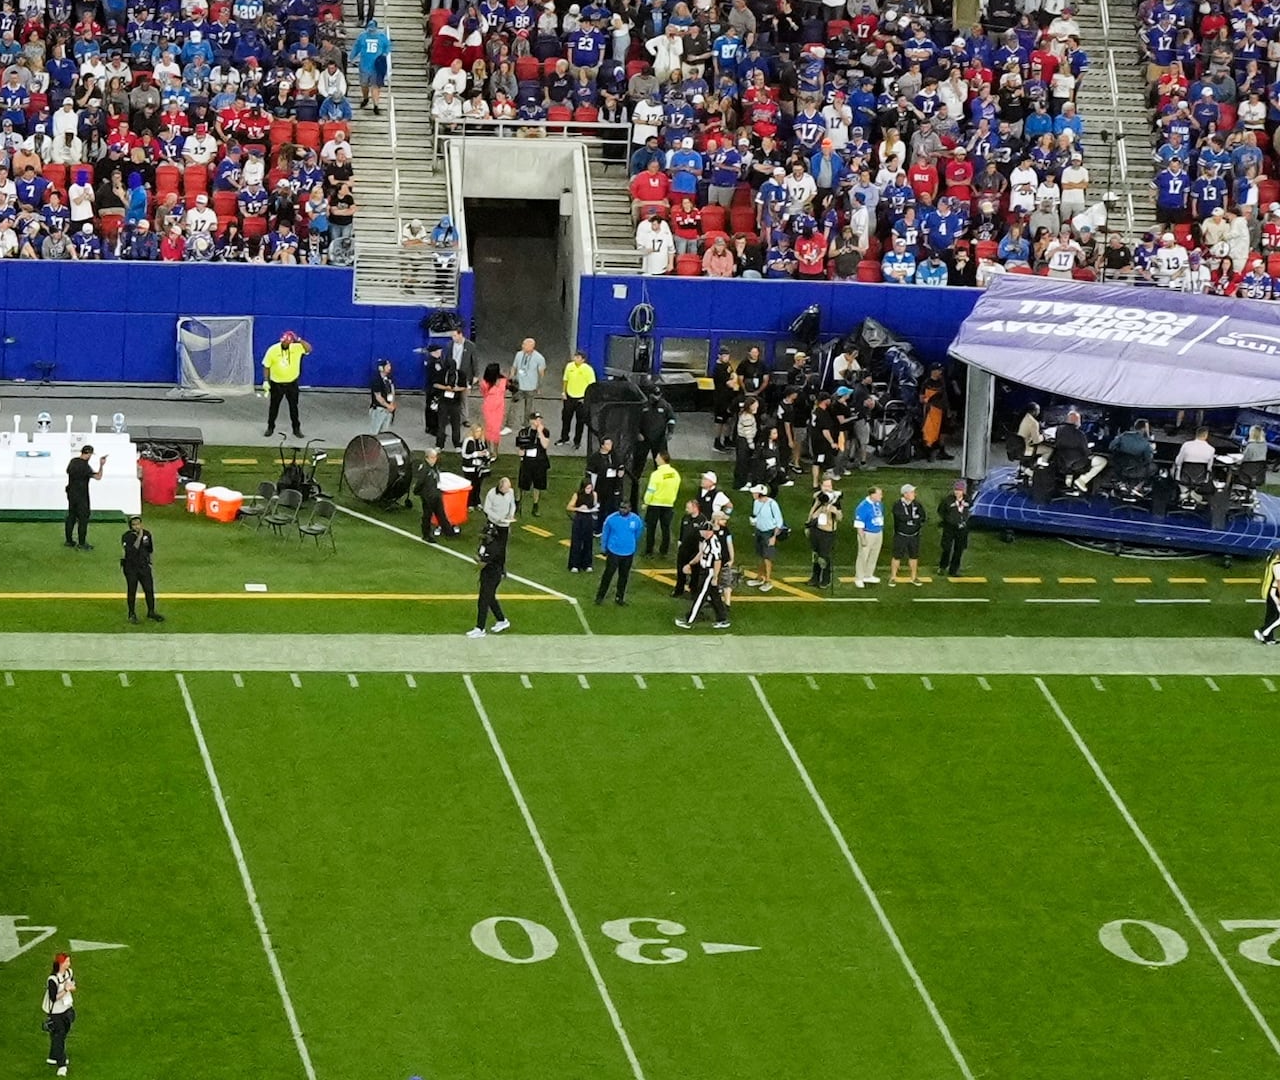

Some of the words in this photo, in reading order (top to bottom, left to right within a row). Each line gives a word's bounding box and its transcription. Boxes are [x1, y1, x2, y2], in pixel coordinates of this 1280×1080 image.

[515, 14, 530, 28] 88
[366, 39, 378, 53] 16
[578, 37, 593, 51] 23
[1158, 36, 1172, 51] 17
[801, 124, 817, 138] 17
[26, 185, 35, 197] 7
[1169, 179, 1183, 193] 17
[1203, 187, 1216, 200] 13
[939, 223, 946, 235] 4
[1058, 254, 1070, 266] 17
[1166, 257, 1180, 270] 13
[1018, 300, 1198, 330] FOOTBALL
[1077, 316, 1181, 335] NIGHT
[977, 320, 1170, 347] THURSDAY
